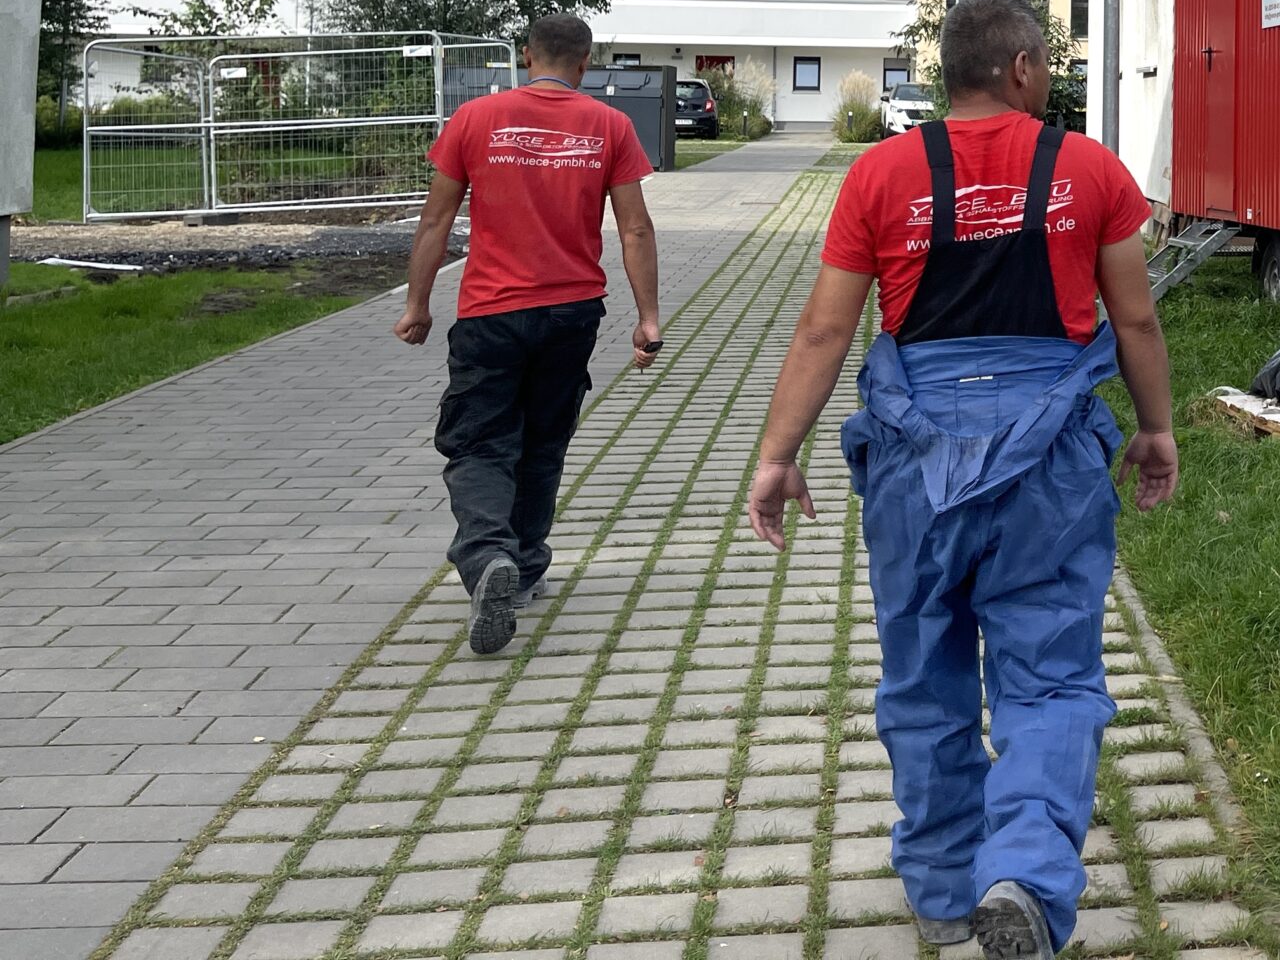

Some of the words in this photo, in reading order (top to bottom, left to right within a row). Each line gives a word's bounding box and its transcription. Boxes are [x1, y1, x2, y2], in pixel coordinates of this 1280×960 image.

[562, 137, 604, 147] BAU
[488, 155, 602, 169] www.yuece-gmbh.de
[1010, 183, 1072, 205] BU
